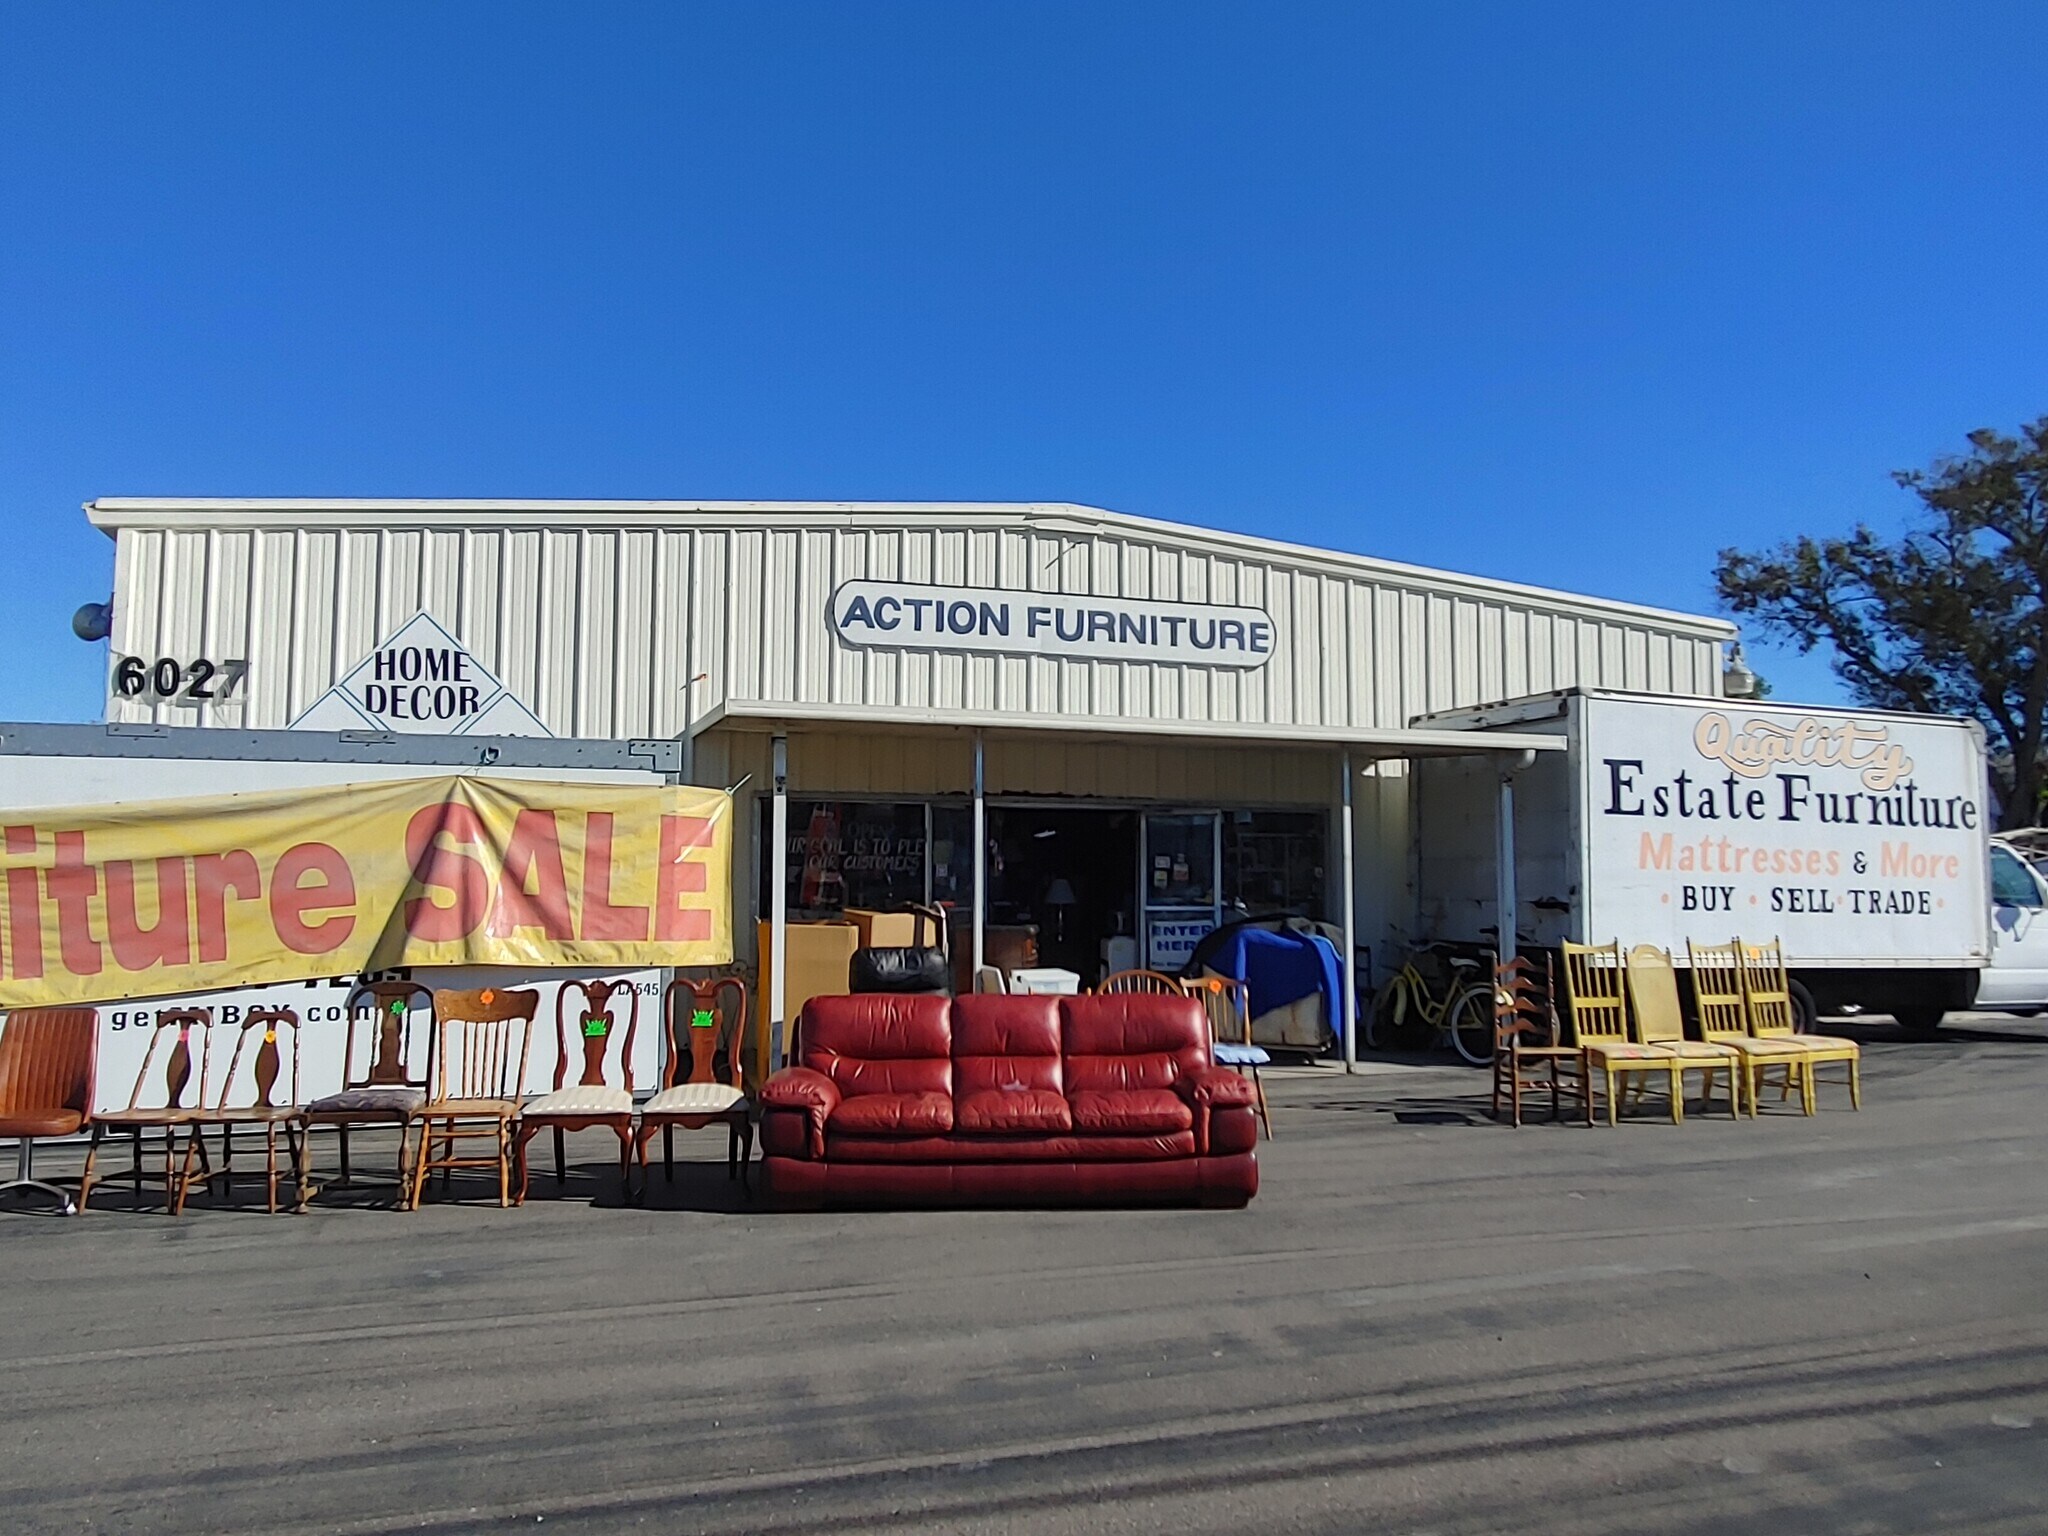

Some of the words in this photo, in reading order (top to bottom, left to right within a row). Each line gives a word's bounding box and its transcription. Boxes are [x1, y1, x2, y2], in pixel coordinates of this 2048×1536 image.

[840, 595, 1009, 636] ACTION
[1027, 606, 1269, 653] FURNITURE
[118, 656, 247, 699] 6027
[375, 647, 471, 682] HOME
[366, 685, 479, 720] DECOR
[1694, 712, 1914, 791] Quality
[1603, 758, 1765, 821] Estate
[1776, 774, 1977, 831] Furniture
[787, 838, 806, 854] UR
[873, 839, 891, 856] TO
[1638, 832, 1840, 877] Mattresses
[1853, 851, 1868, 874] &
[1880, 841, 1959, 879] More
[0, 824, 356, 980] iture
[404, 802, 714, 942] SALE
[1682, 885, 1736, 912] BUY
[1771, 886, 1834, 913] SELL
[1848, 889, 1931, 915] TRADE
[1152, 925, 1213, 936] ENTER
[1157, 941, 1196, 951] HER
